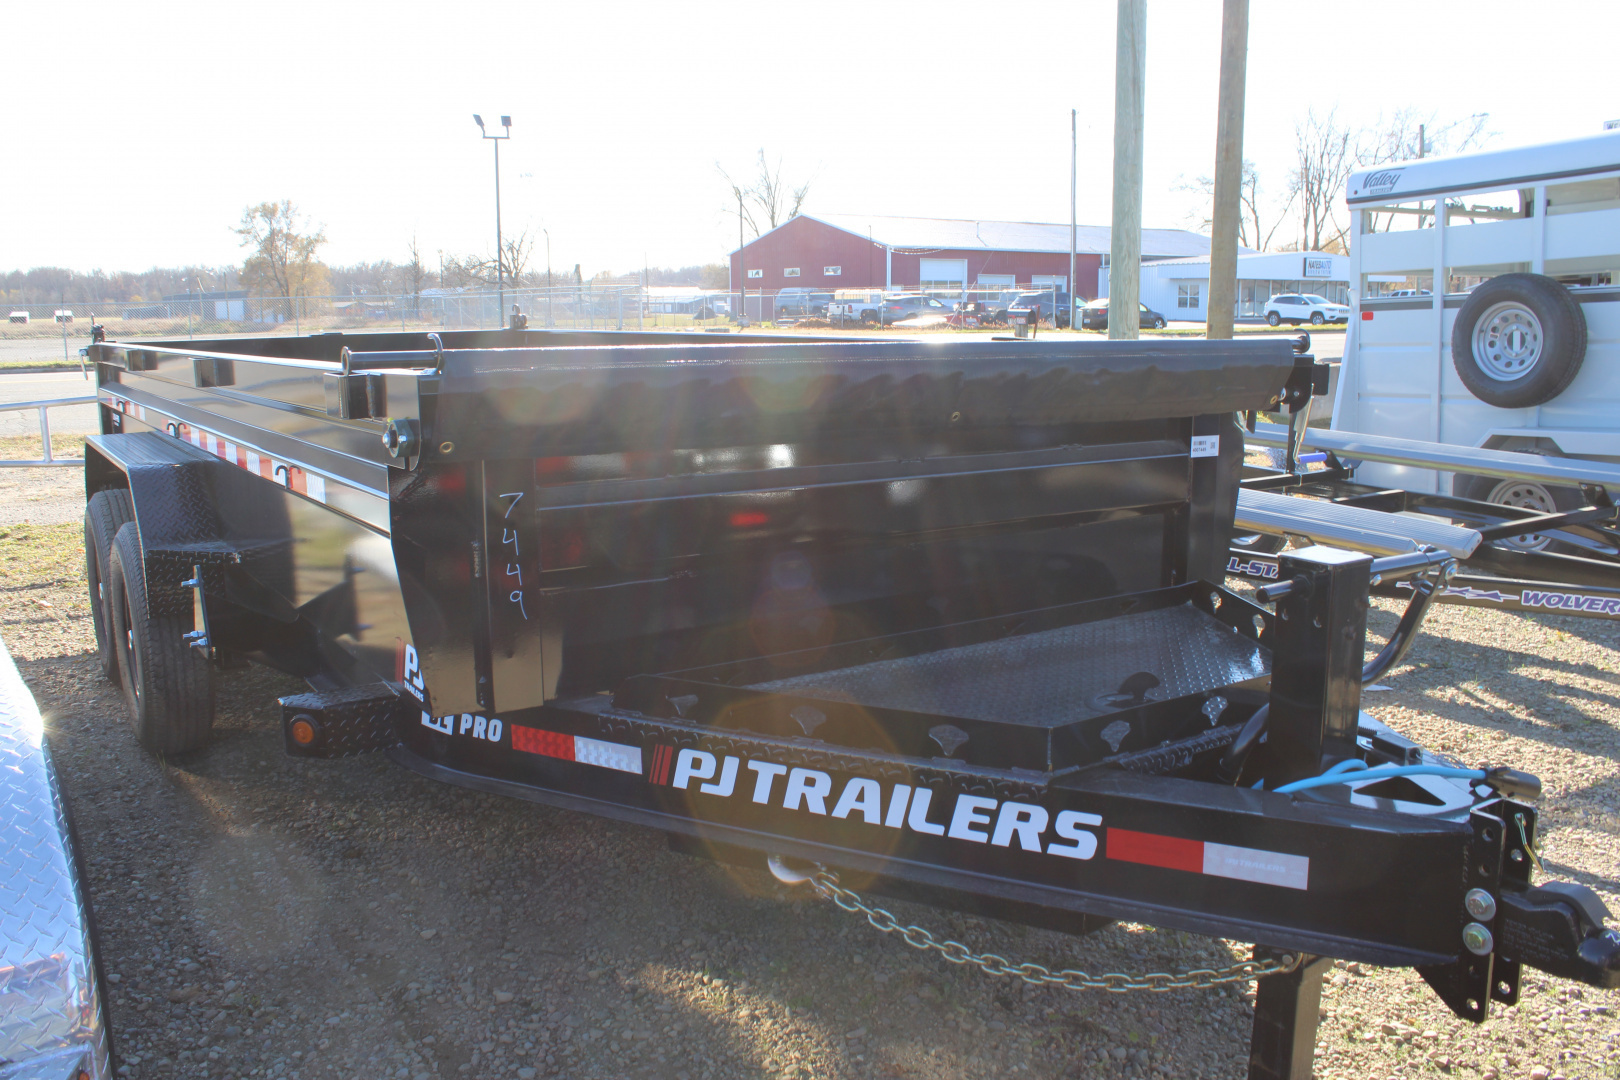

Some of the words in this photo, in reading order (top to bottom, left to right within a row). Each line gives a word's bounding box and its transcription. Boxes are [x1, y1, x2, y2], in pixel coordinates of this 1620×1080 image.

[1363, 167, 1406, 193] Valley
[499, 491, 528, 621] 7449
[1521, 589, 1620, 616] WOLVER
[403, 679, 425, 703] TRAILERS
[459, 712, 503, 743] PRO
[673, 748, 740, 798] PJ
[747, 759, 1103, 861] TRAILERS
